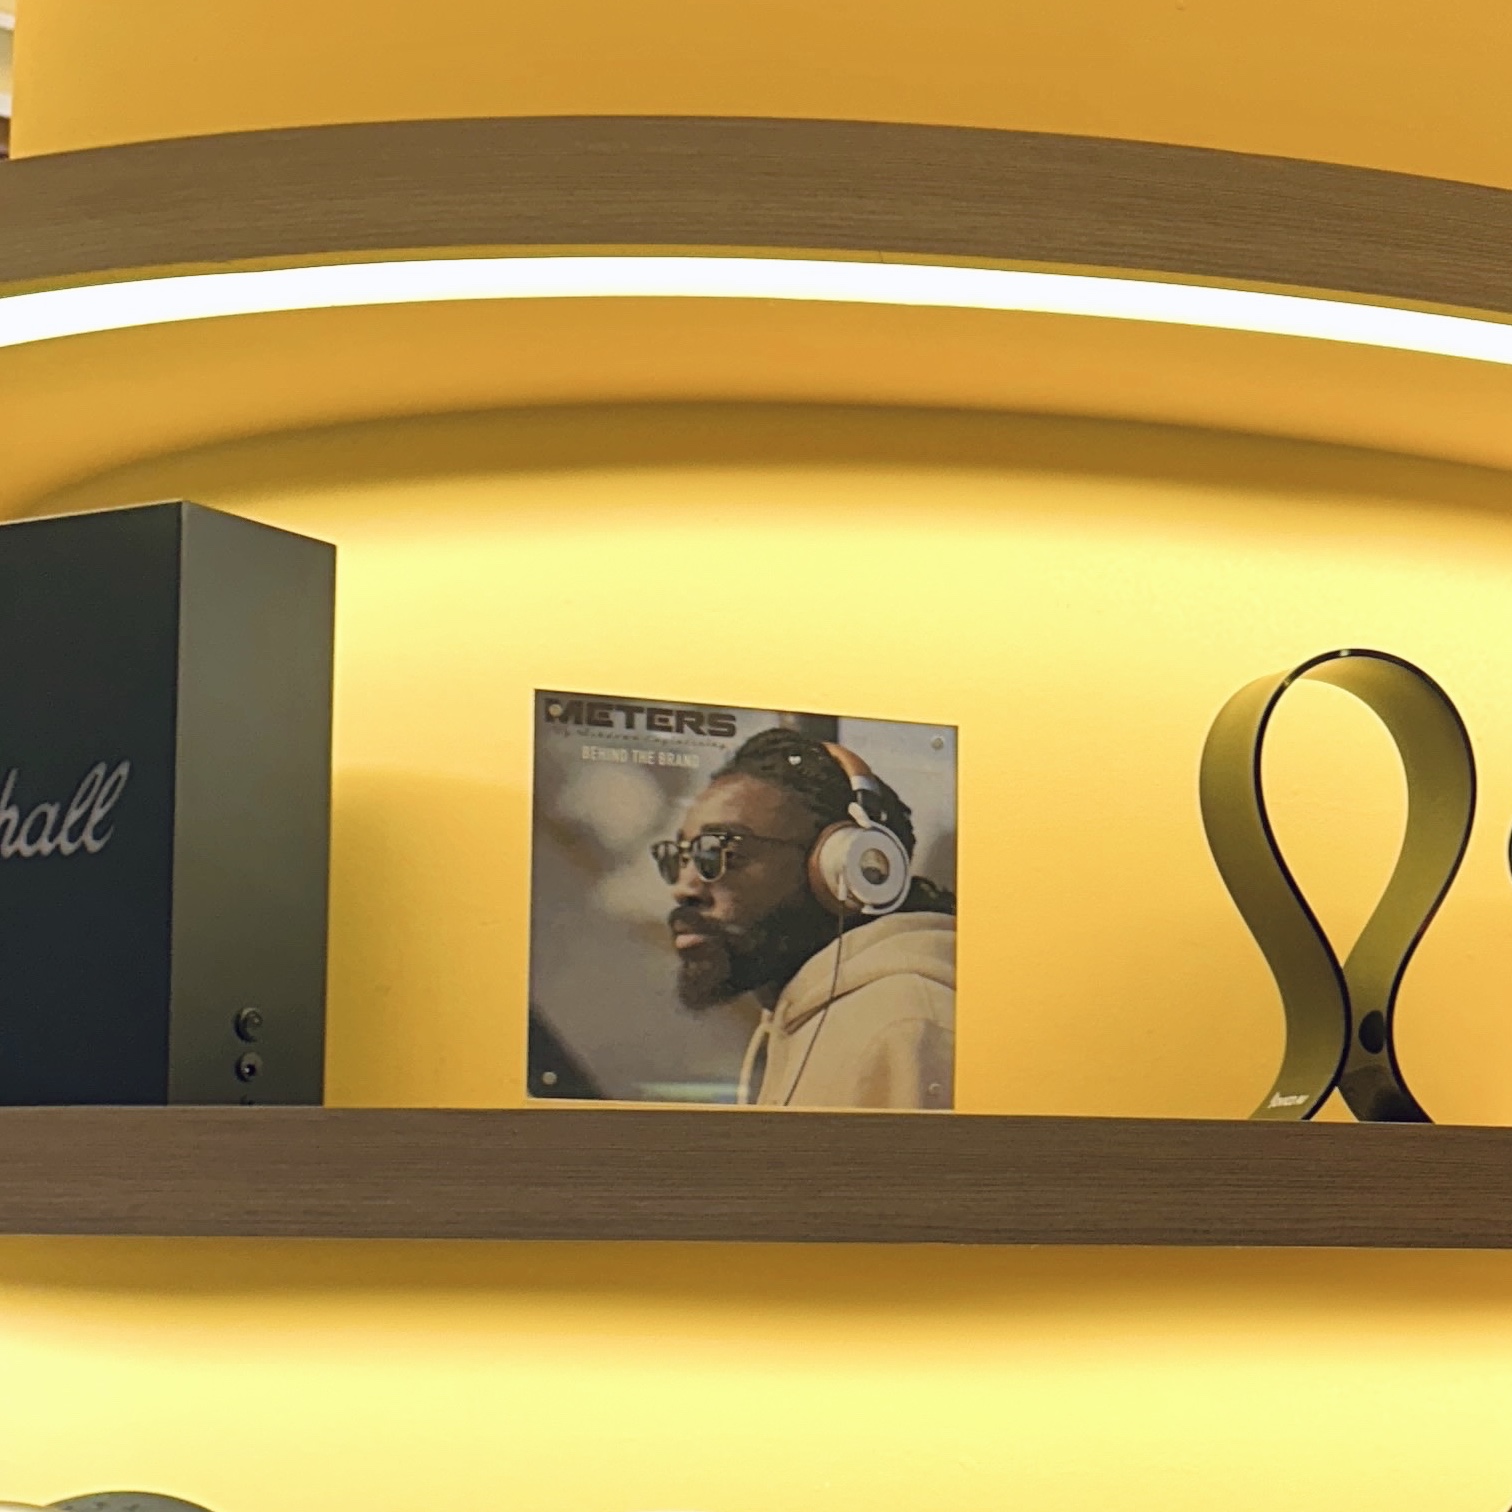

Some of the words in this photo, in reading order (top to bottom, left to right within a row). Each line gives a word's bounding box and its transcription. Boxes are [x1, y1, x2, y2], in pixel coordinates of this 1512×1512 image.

[545, 697, 736, 737] METERS
[582, 746, 627, 763] BEHIND
[632, 749, 654, 765] THE
[658, 751, 699, 768] BRAND
